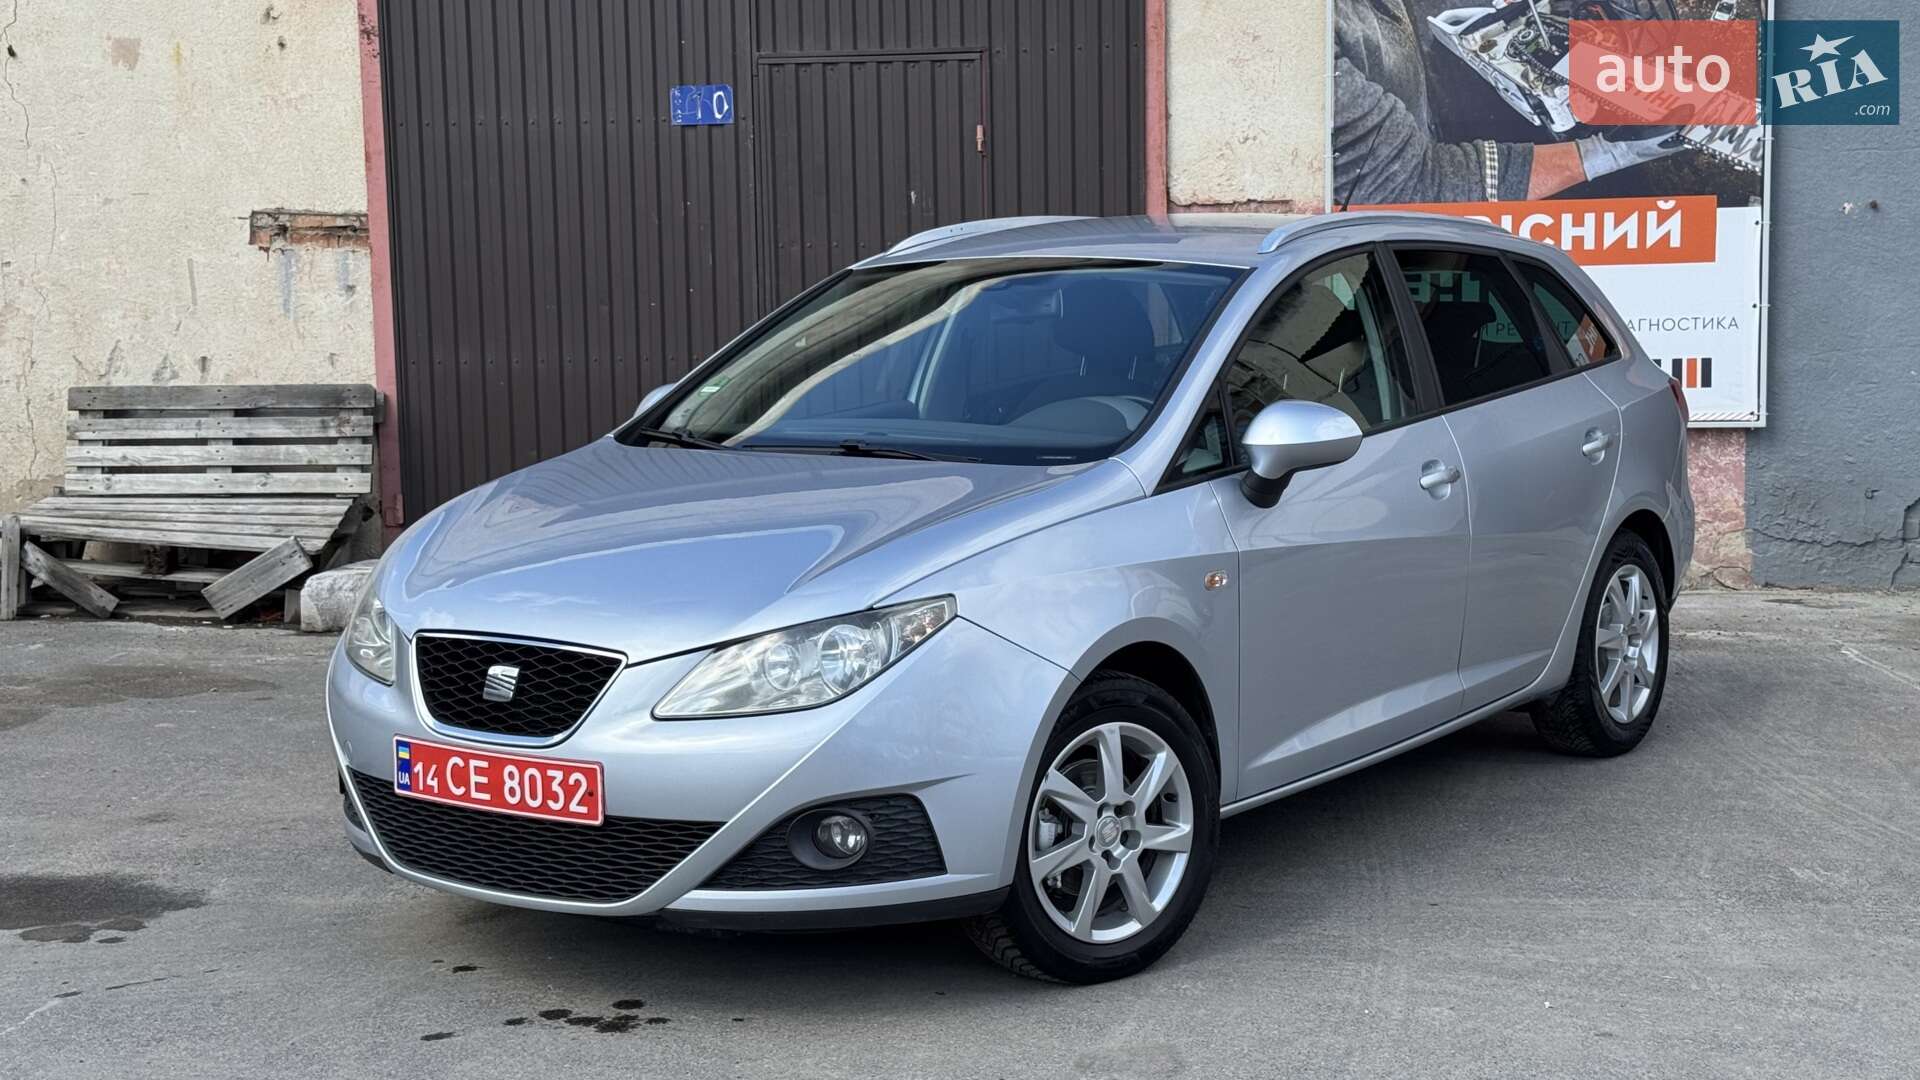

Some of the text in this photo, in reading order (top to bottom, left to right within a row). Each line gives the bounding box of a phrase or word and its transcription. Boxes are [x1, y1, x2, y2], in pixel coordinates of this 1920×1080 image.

[1627, 316, 1740, 332] АГНОСТИКА
[398, 771, 411, 785] UA
[413, 756, 588, 814] 14 CE 8032
